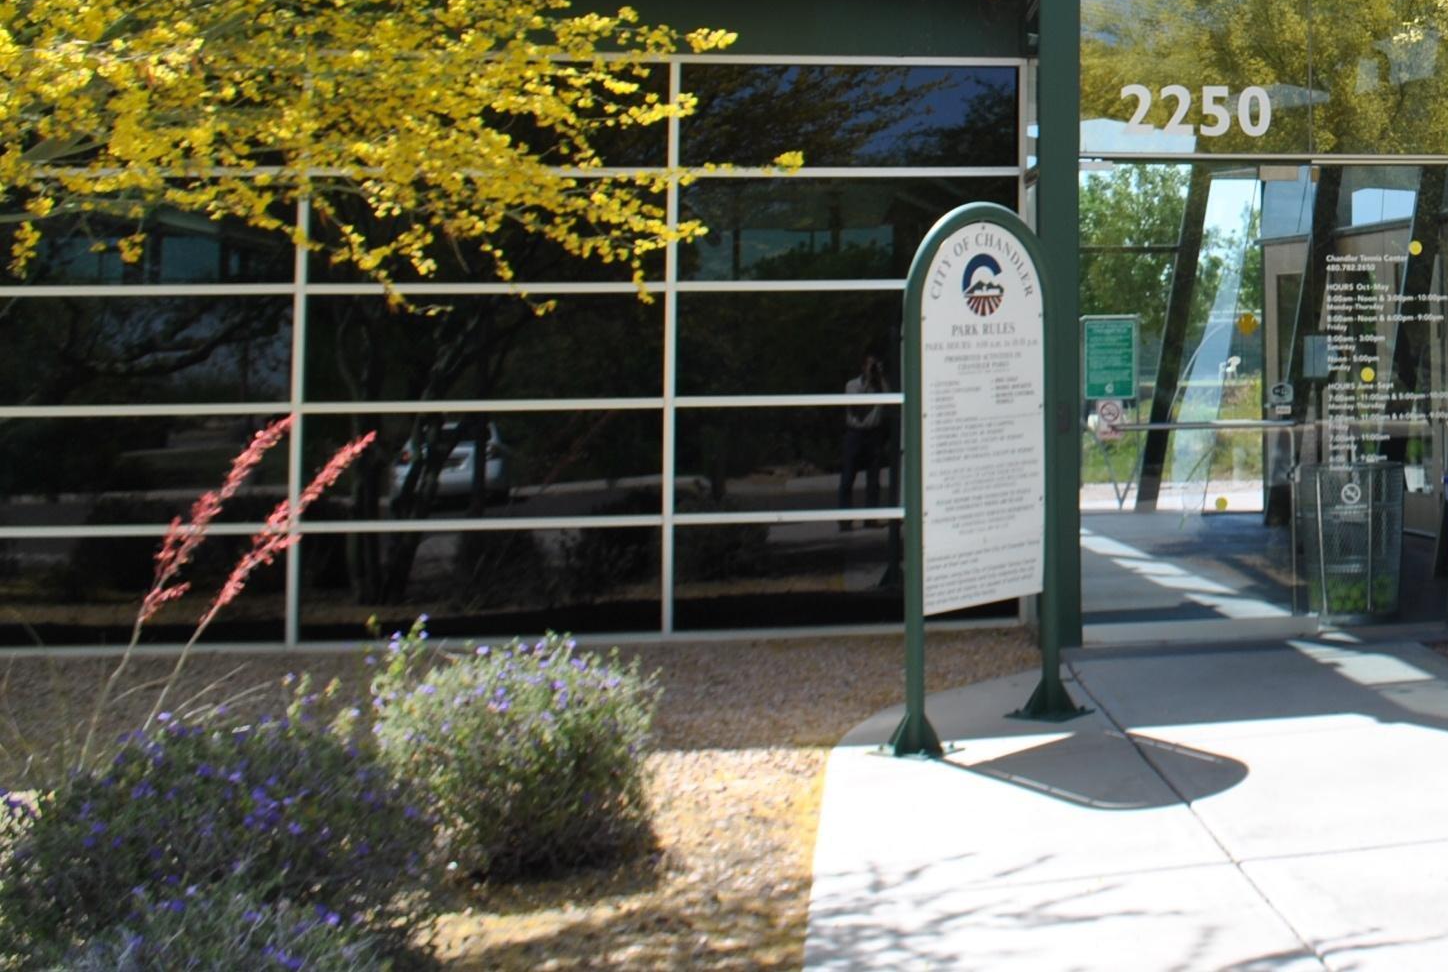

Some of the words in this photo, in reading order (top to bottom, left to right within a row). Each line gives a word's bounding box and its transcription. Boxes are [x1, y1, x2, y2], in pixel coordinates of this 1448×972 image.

[1120, 84, 1272, 137] 2250
[1326, 254, 1358, 262] Chandler
[1360, 254, 1382, 262] Tennis
[1383, 253, 1408, 261] Center
[930, 255, 952, 301] CITY
[953, 235, 972, 257] OF
[974, 232, 1034, 297] CHANDLER
[1327, 283, 1354, 291] HOURS
[951, 323, 979, 337] PARK
[982, 322, 1016, 335] RULES
[1327, 324, 1348, 333] Friday
